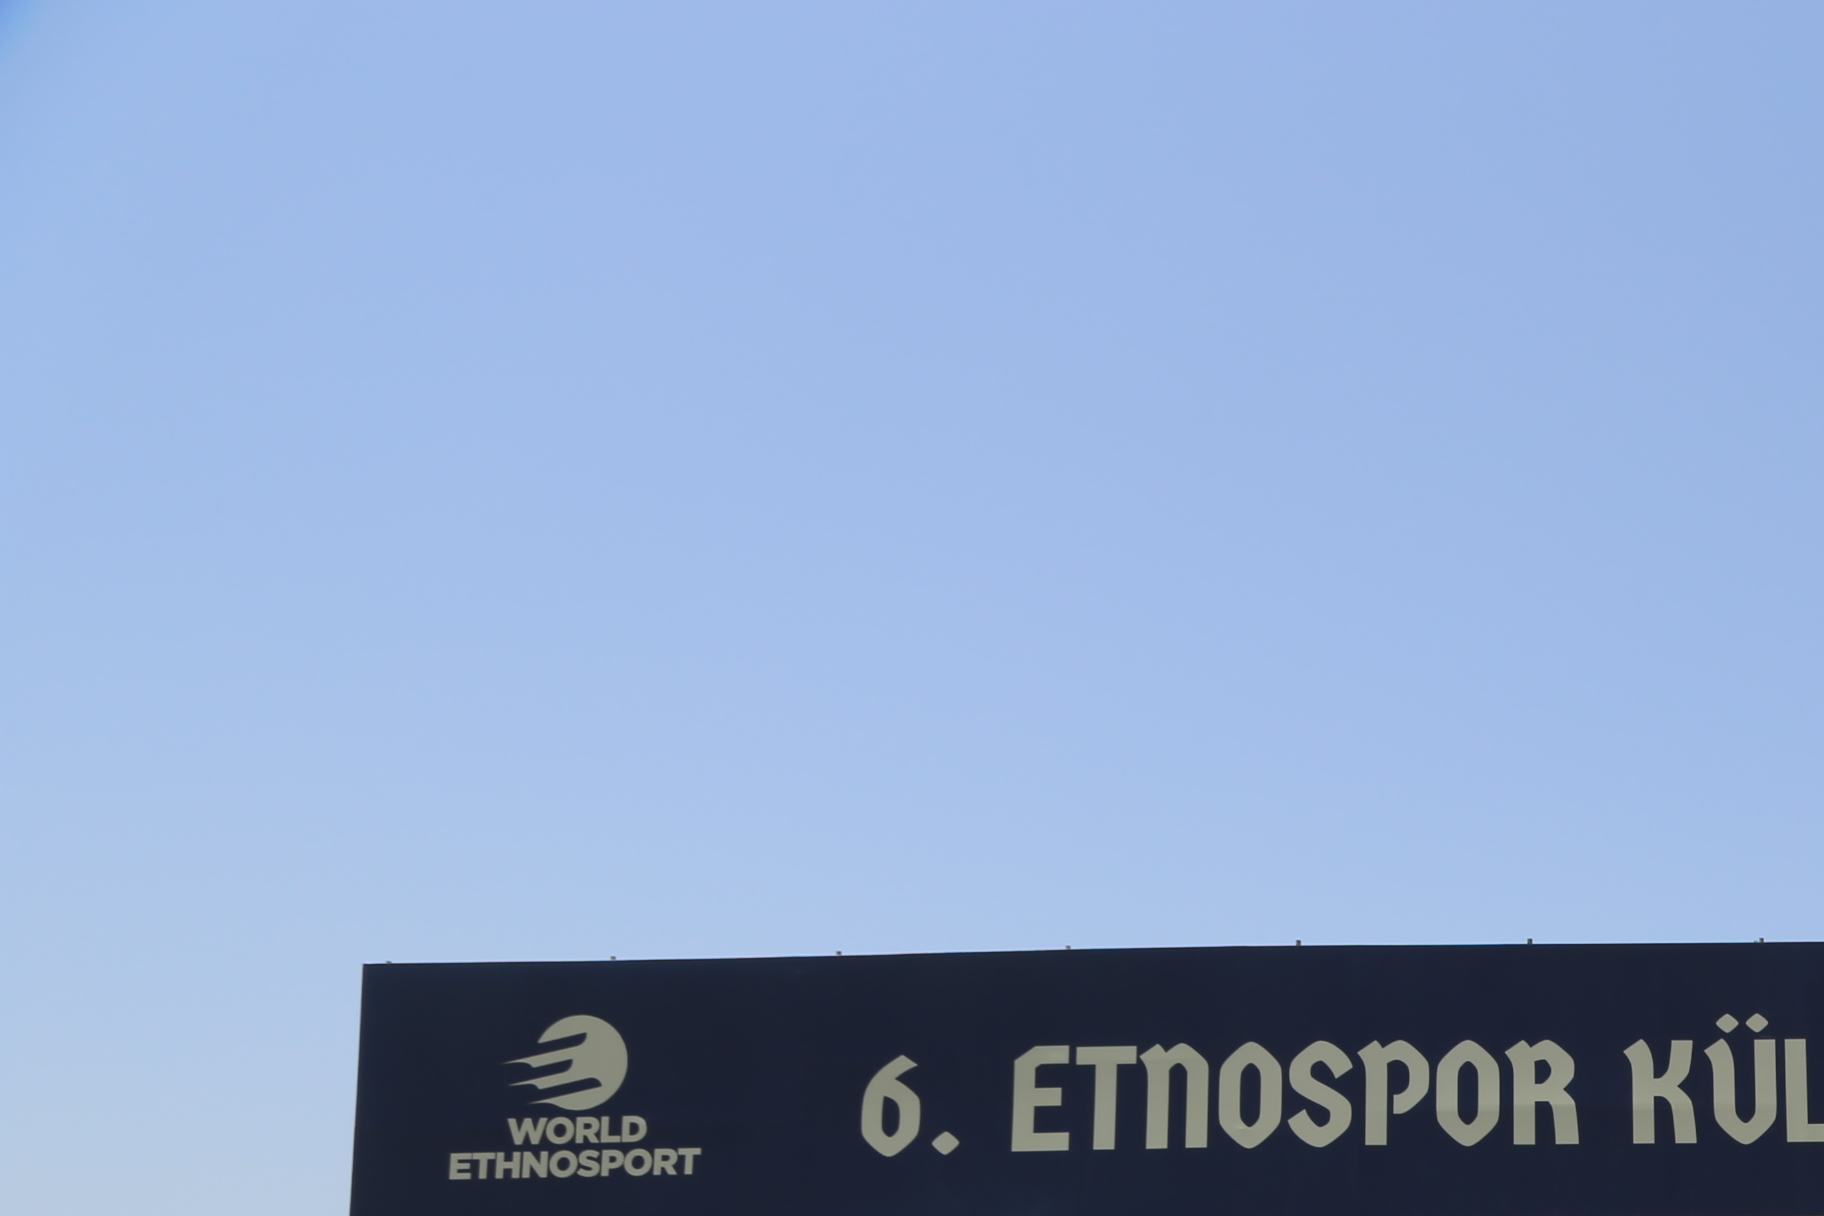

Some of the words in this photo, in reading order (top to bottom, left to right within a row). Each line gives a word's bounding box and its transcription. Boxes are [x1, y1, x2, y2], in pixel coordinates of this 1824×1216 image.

[860, 1054, 960, 1158] 6.
[1010, 1039, 1580, 1153] ETNOSPOR
[507, 1115, 648, 1146] WORLD
[448, 1147, 702, 1181] ETHNOSPORT
